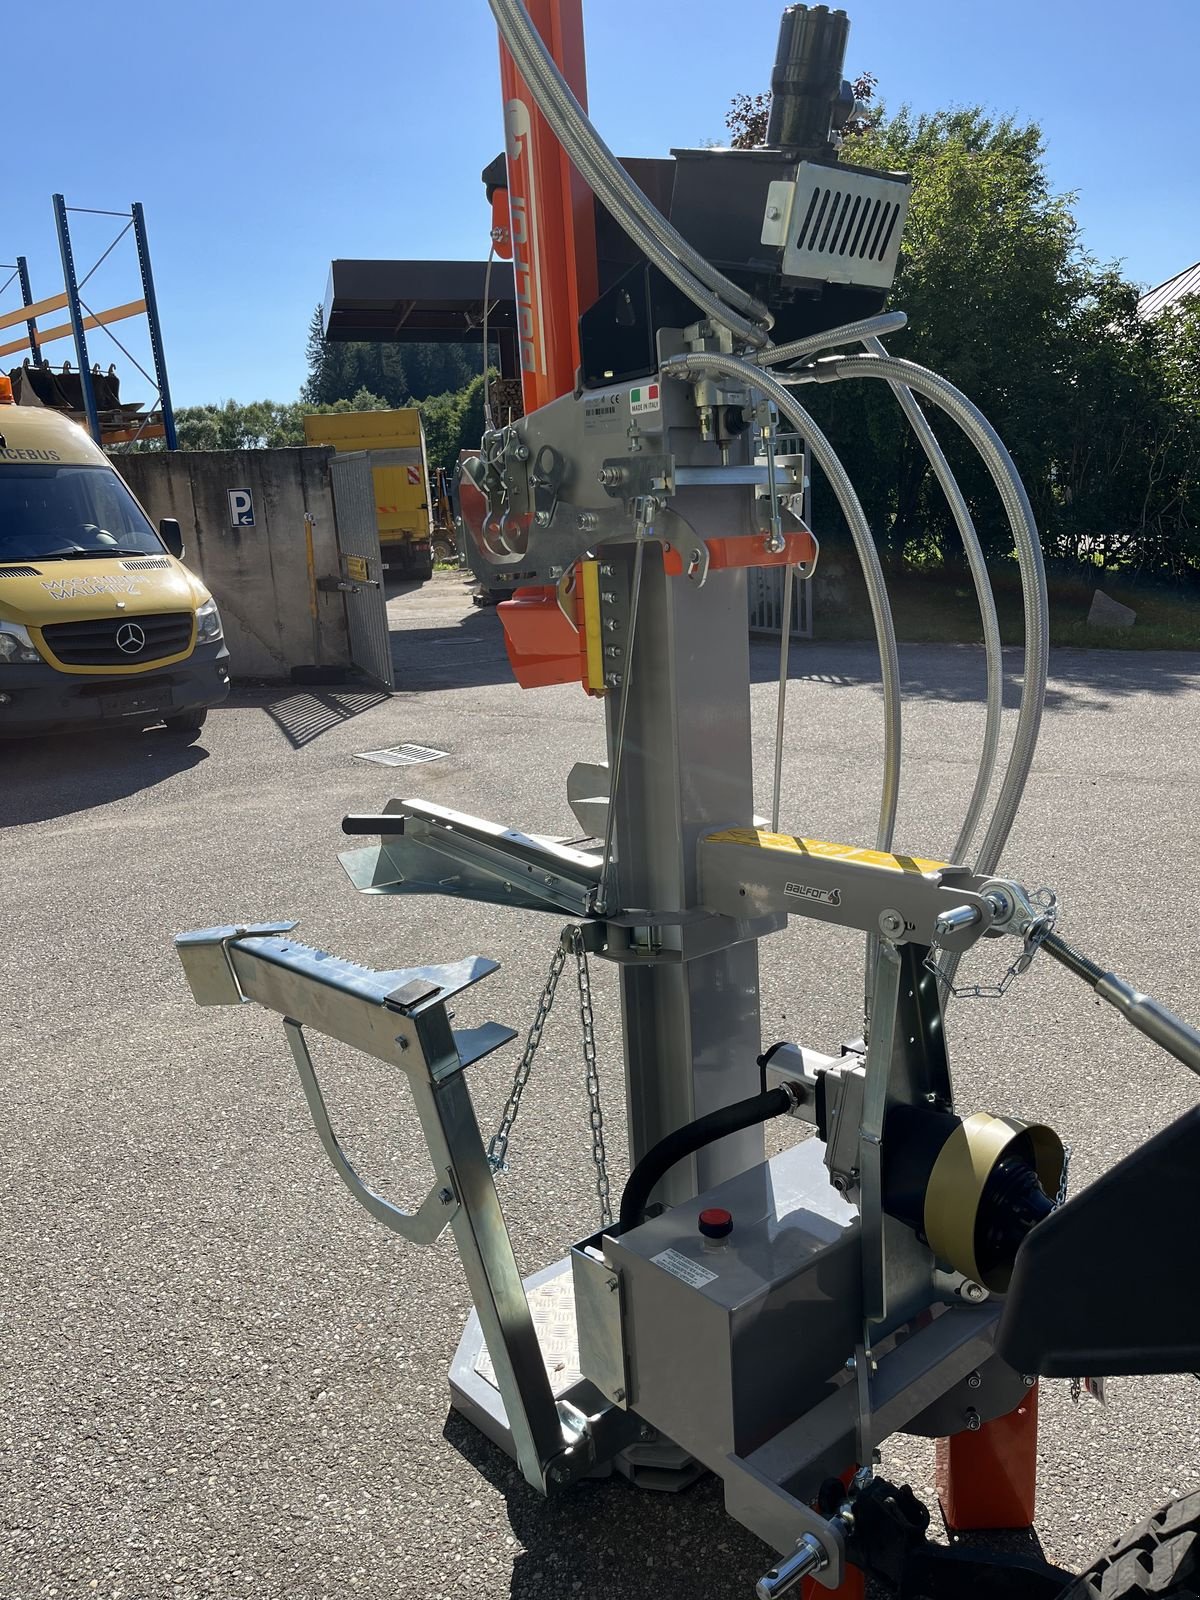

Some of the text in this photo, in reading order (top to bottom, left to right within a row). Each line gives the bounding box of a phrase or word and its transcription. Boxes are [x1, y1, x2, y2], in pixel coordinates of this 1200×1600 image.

[632, 404, 643, 412] MADE
[648, 401, 659, 409] ITALY
[229, 491, 251, 525] P
